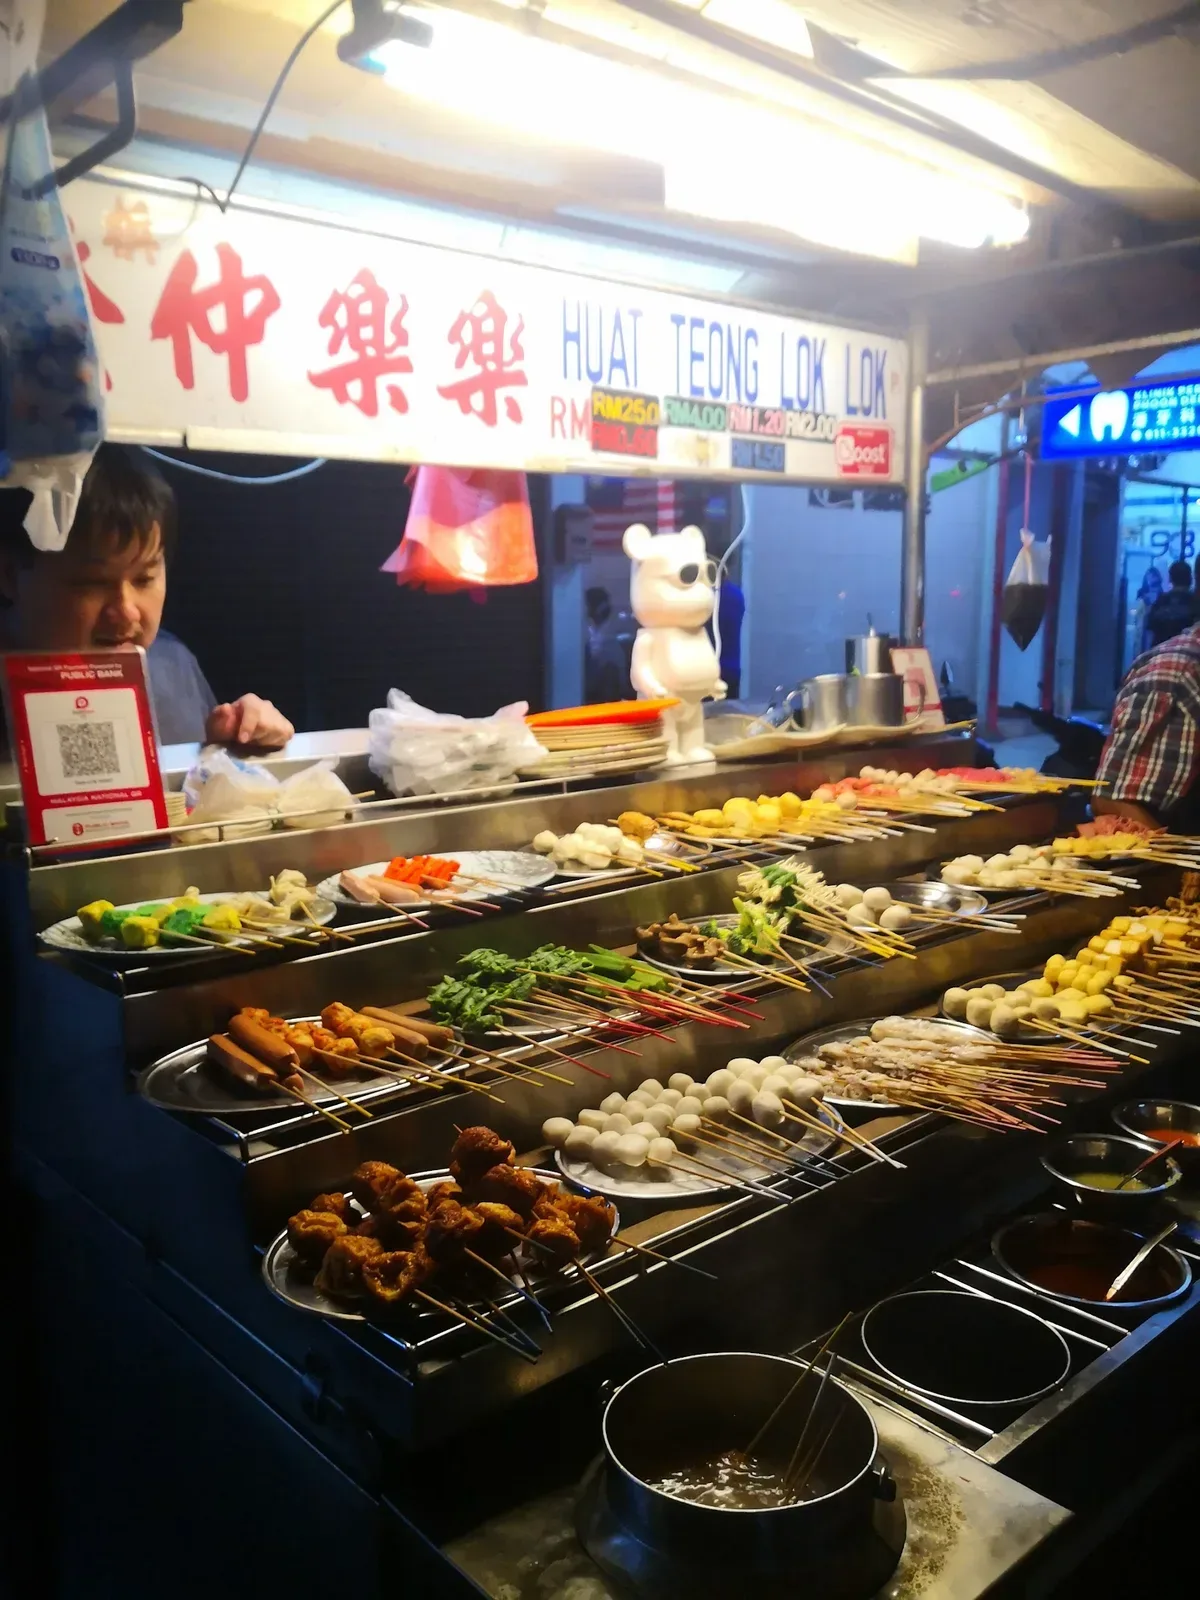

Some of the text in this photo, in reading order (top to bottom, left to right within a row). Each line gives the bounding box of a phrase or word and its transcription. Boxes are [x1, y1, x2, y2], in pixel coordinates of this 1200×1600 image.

[563, 295, 889, 420] HUAT TEONG LOK LOK
